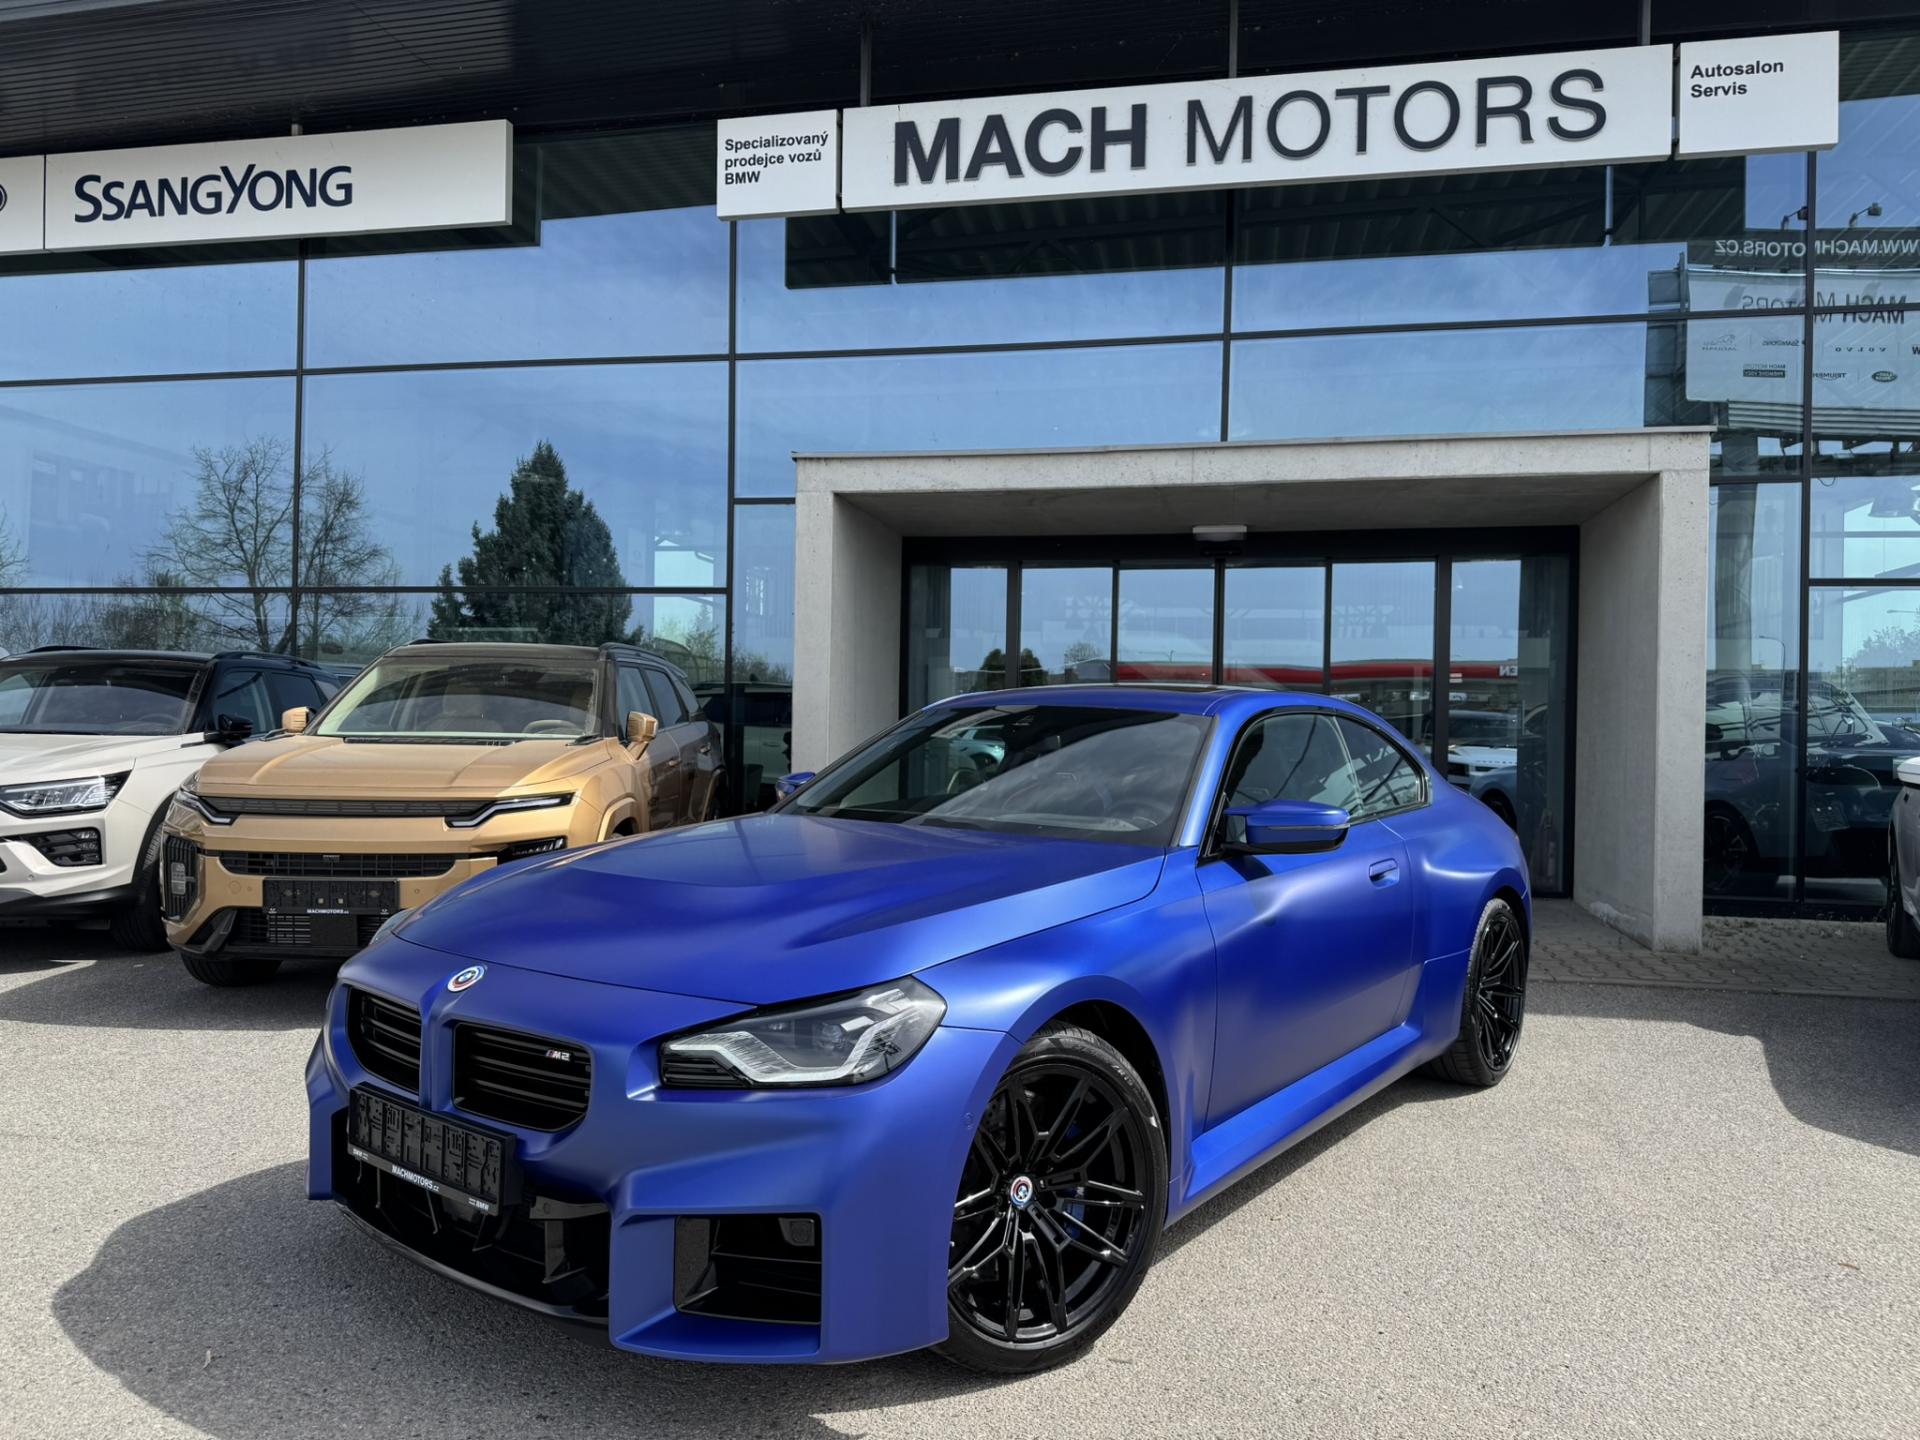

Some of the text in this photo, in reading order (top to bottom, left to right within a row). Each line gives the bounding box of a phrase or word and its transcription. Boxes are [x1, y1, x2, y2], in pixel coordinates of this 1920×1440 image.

[1690, 60, 1784, 79] Autosalon
[1690, 81, 1748, 98] Servis
[893, 68, 1608, 187] MACH MOTORS
[724, 131, 829, 153] Specializovaný
[724, 148, 822, 171] prodejce vozů
[724, 170, 761, 185] BMW
